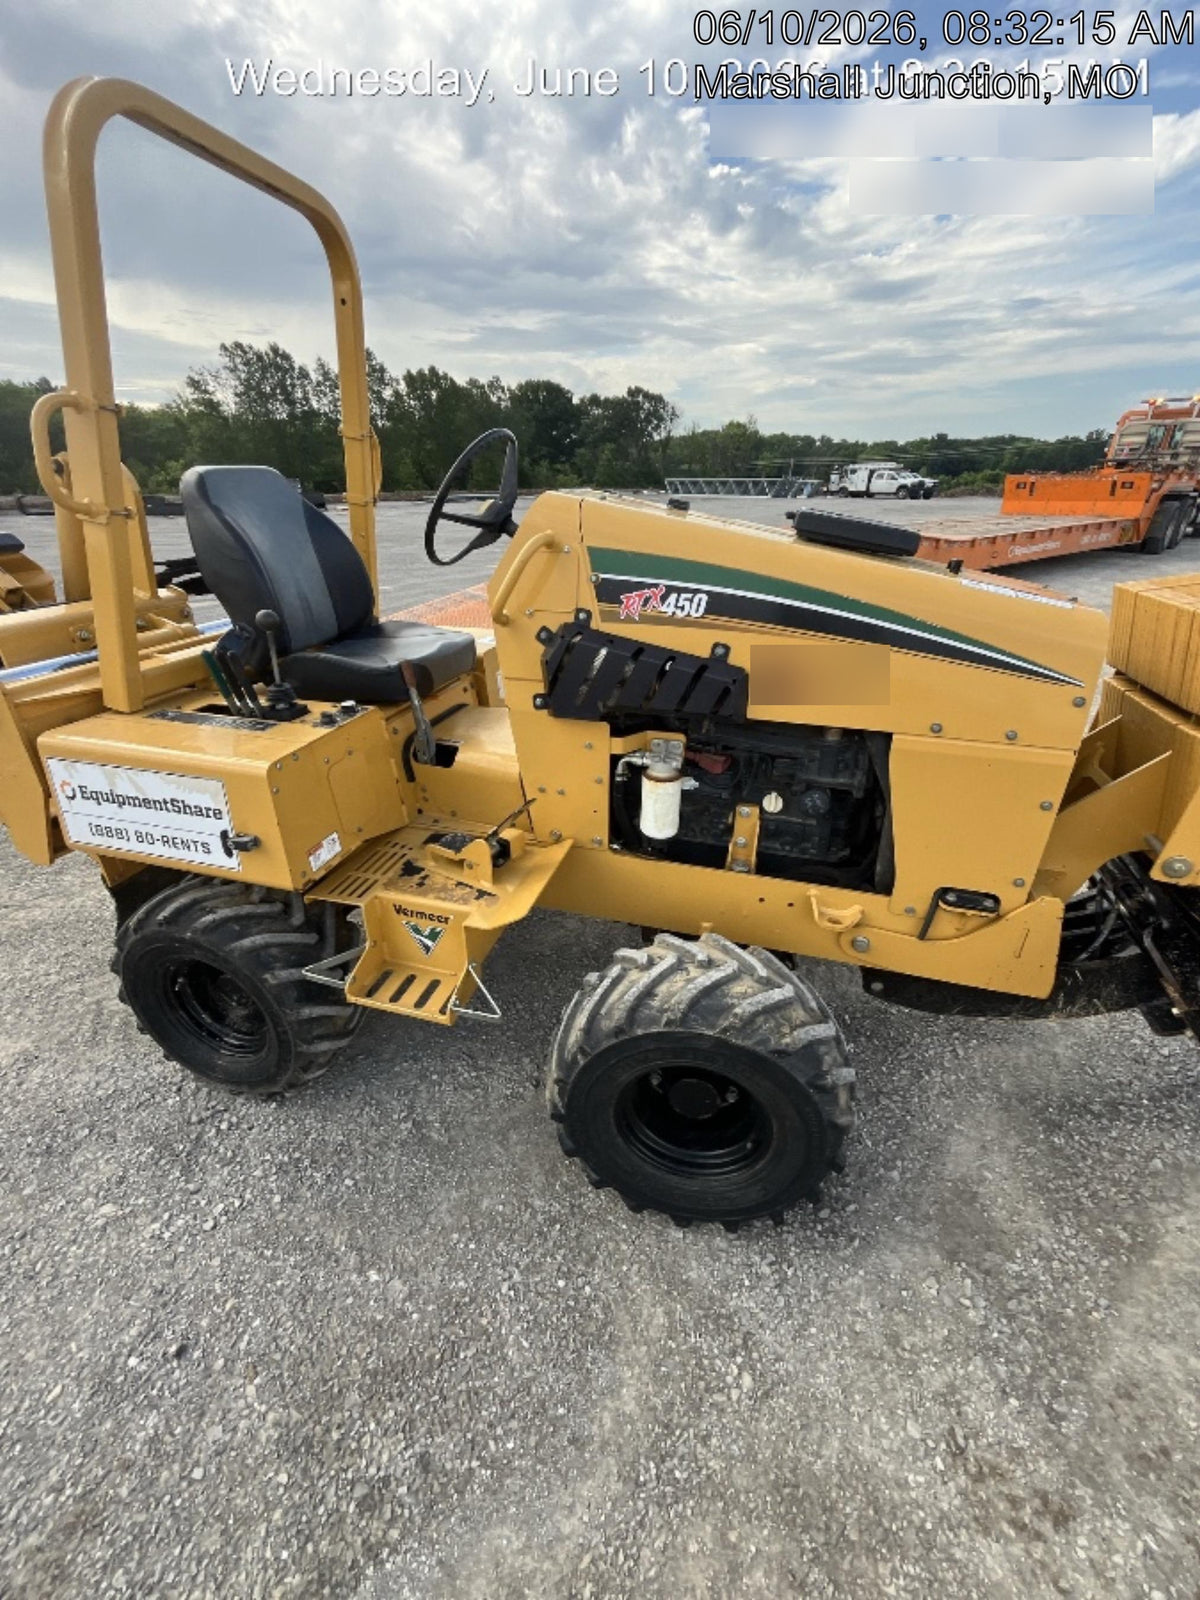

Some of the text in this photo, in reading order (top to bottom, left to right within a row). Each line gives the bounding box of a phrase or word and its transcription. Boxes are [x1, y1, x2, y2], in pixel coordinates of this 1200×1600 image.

[77, 785, 223, 820] EquipmentShare
[88, 822, 212, 855] (888) 80-RENTS
[393, 902, 451, 925] Vermeer
